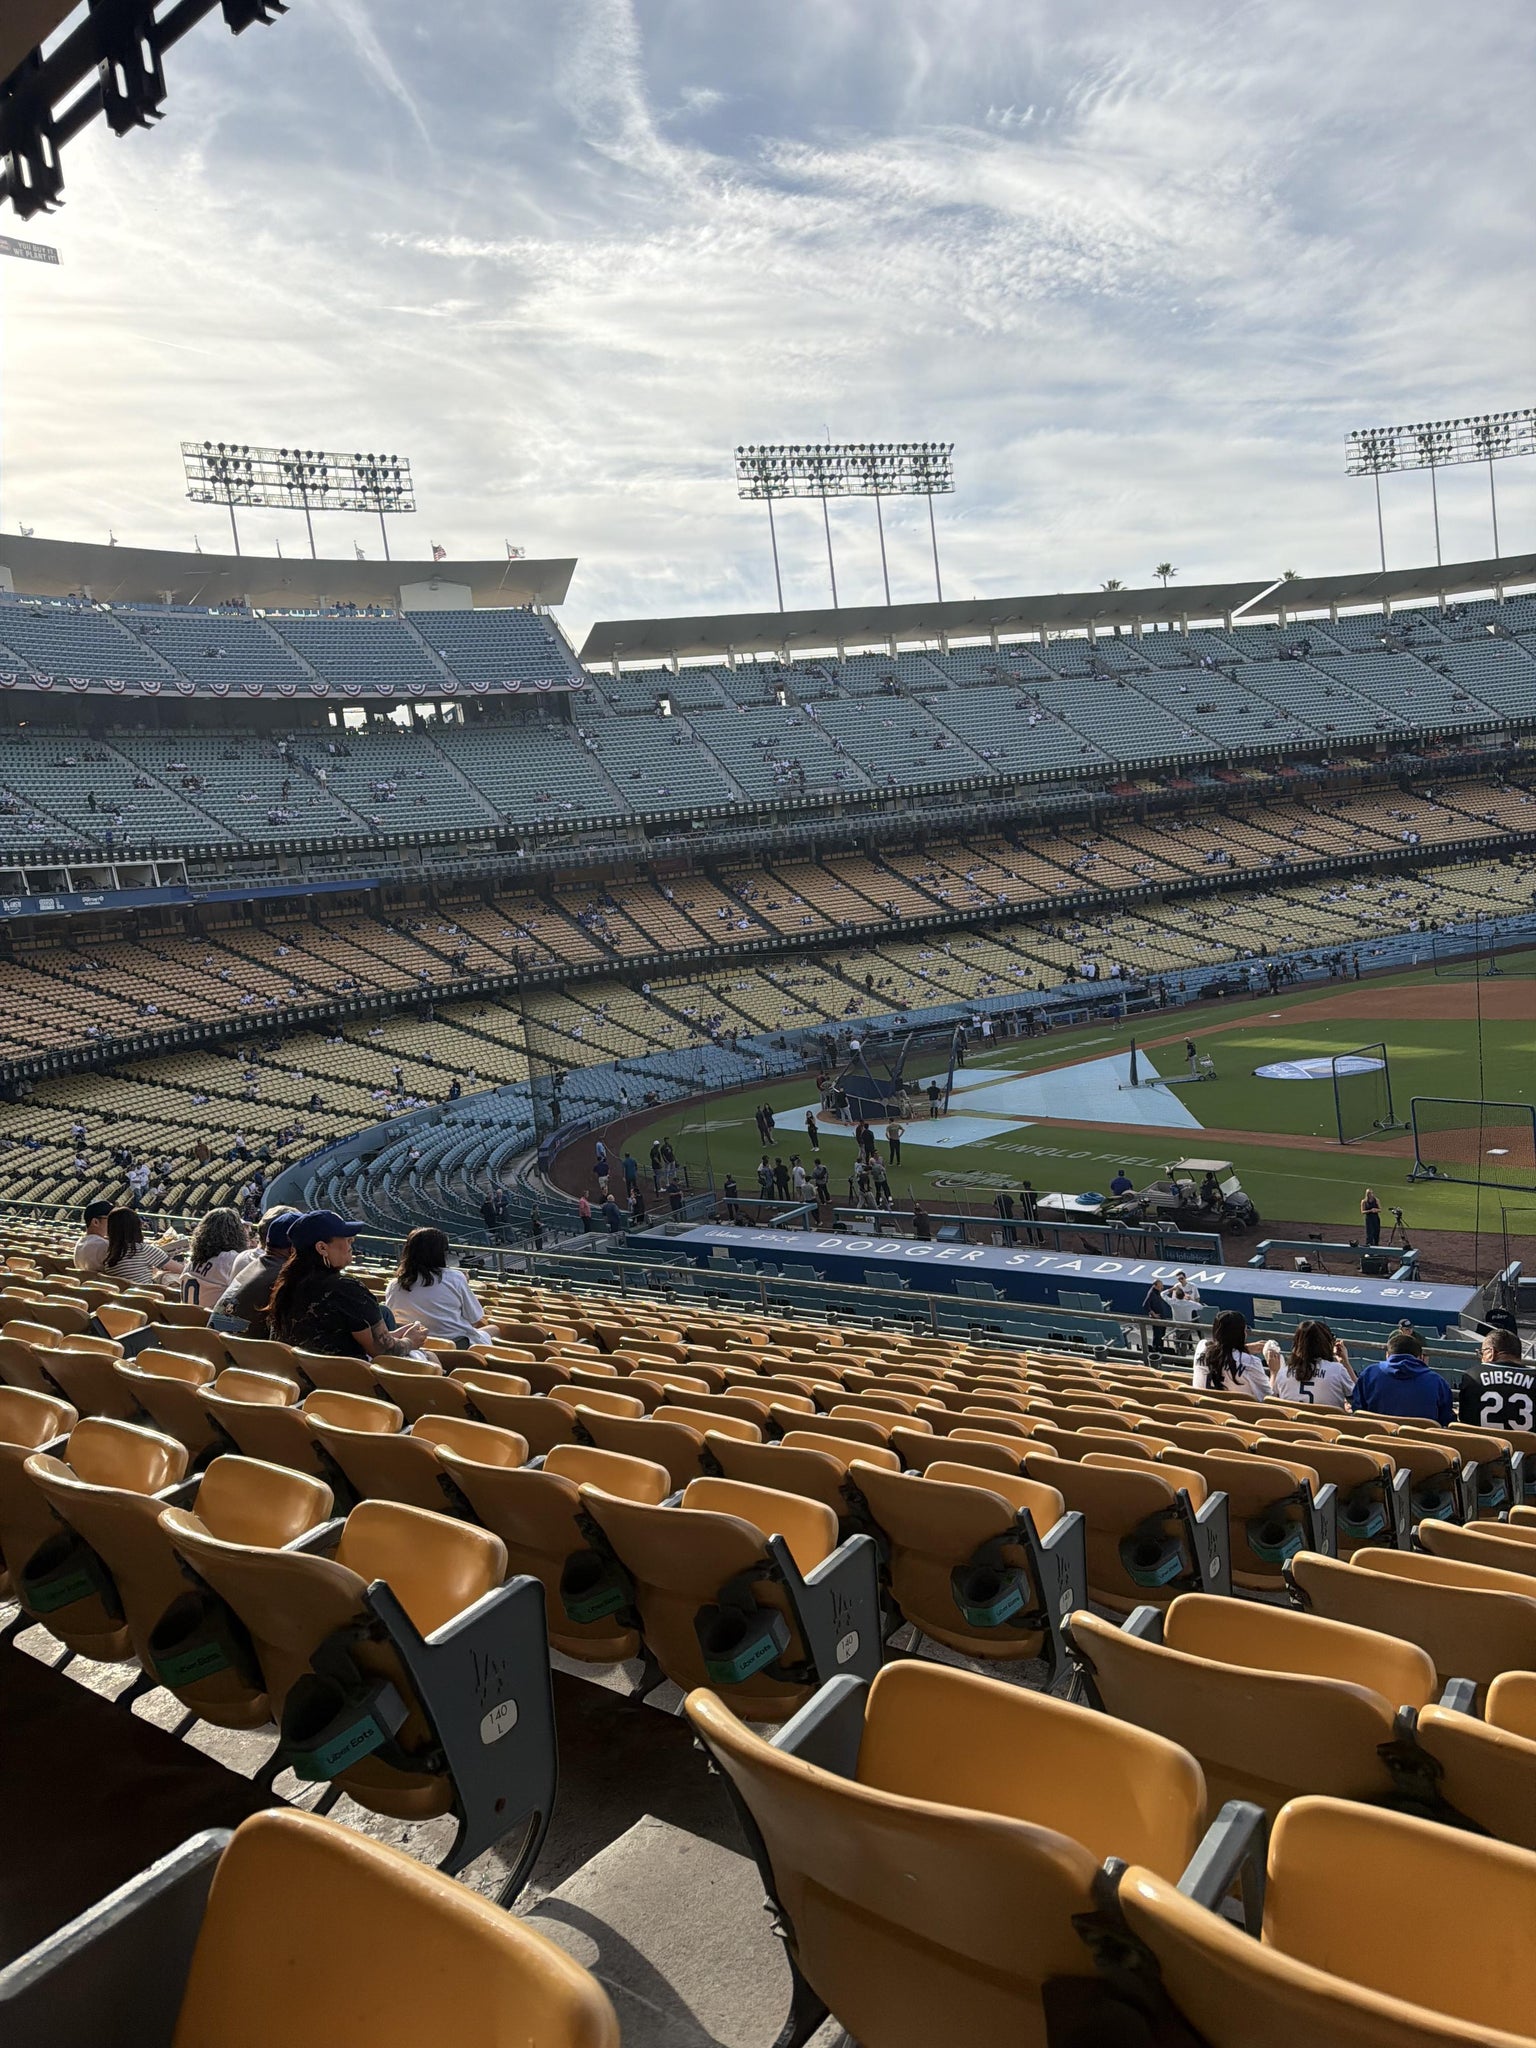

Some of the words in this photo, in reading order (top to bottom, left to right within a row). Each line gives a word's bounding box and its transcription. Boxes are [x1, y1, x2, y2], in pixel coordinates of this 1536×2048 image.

[13, 247, 25, 257] WE
[26, 250, 46, 260] PLANT
[994, 1143, 1092, 1159] UNIQLO
[816, 1238, 985, 1261] DODGER
[1005, 1254, 1227, 1284] STADIUM
[1289, 1279, 1363, 1295] Bienvenido
[1480, 1371, 1534, 1390] GIBSON
[1299, 1381, 1315, 1404] 5
[1480, 1391, 1534, 1431] 23
[739, 1654, 758, 1671] Uber
[754, 1644, 772, 1660] Eats
[489, 1704, 508, 1725] 140
[497, 1723, 504, 1735] L
[327, 1744, 351, 1764] Uber
[349, 1728, 375, 1748] Eats
